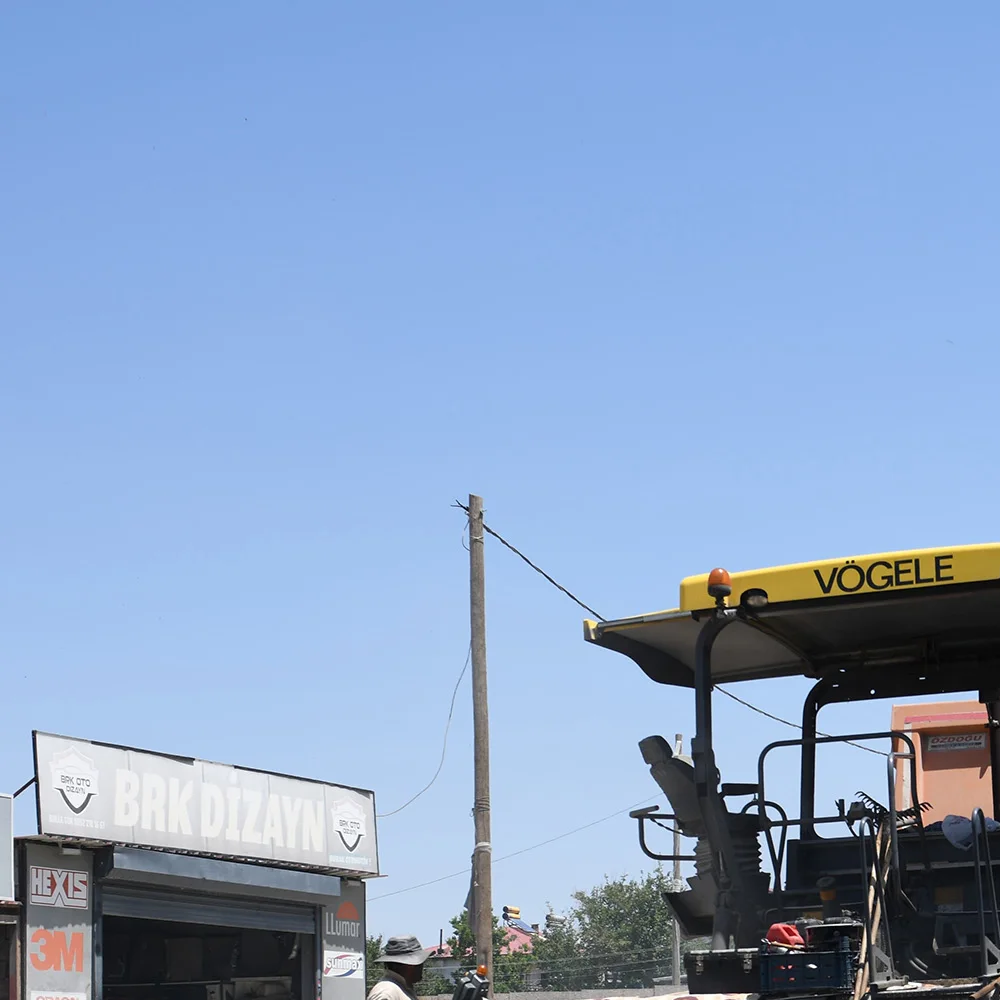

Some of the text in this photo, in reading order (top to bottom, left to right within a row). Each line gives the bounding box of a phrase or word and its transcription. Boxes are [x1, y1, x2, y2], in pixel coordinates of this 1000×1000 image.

[813, 555, 954, 594] VÖGELE
[60, 775, 91, 788] BRK OTO
[114, 768, 325, 852] BRK DİZAYN
[31, 867, 87, 907] HEXIS
[30, 928, 84, 972] 3M
